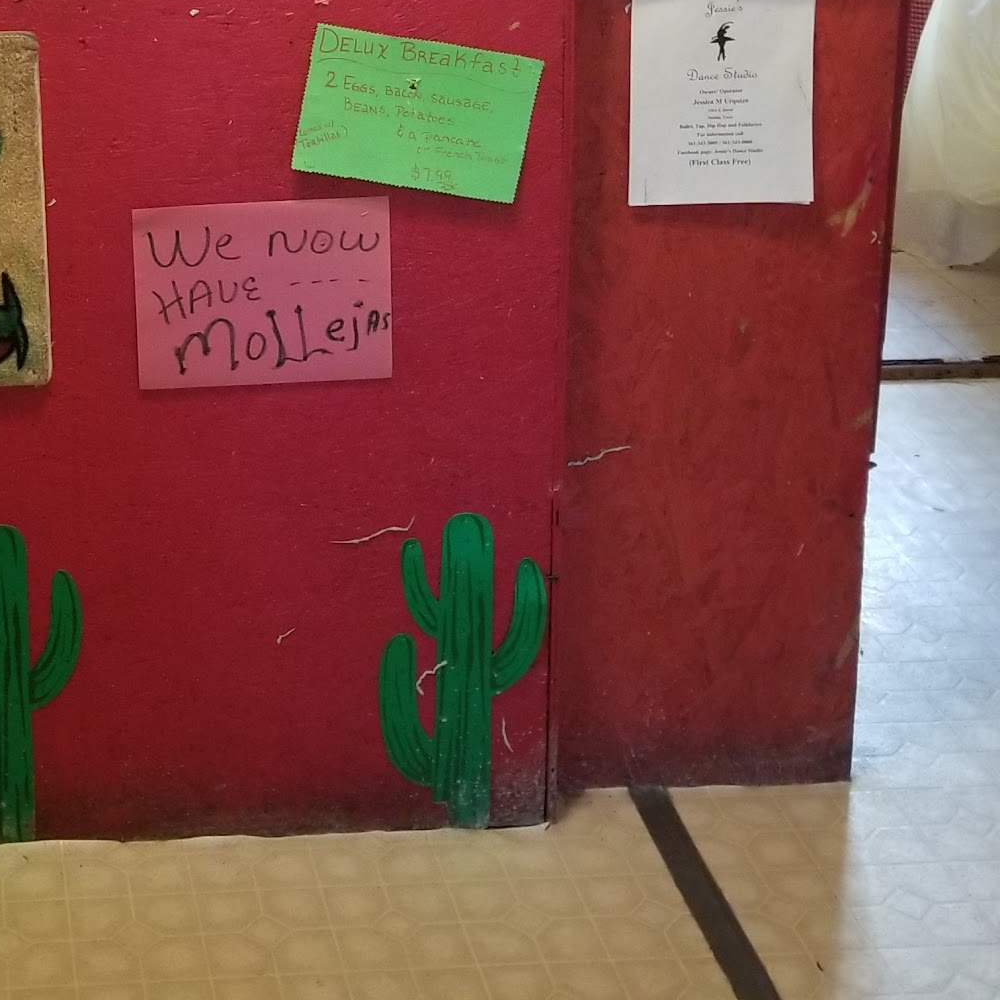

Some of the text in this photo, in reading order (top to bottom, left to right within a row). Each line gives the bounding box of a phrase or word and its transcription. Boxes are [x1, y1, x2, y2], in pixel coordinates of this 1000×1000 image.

[325, 71, 338, 88] 2
[687, 67, 758, 81] Dance Studio
